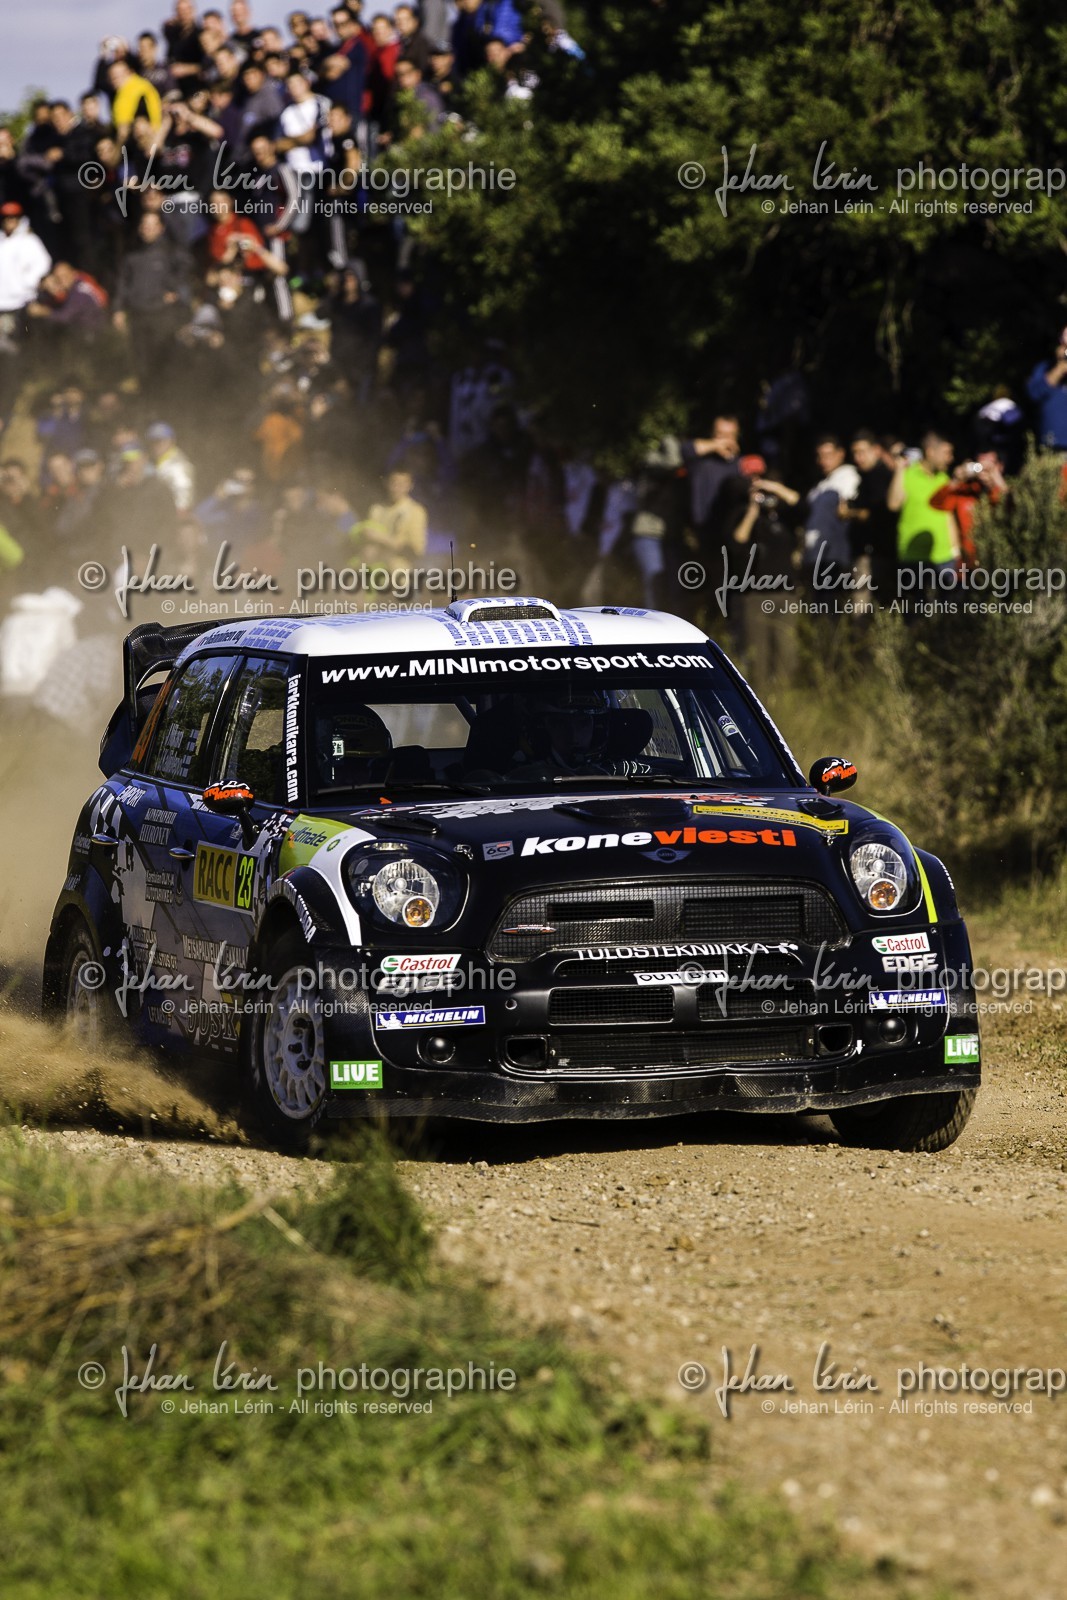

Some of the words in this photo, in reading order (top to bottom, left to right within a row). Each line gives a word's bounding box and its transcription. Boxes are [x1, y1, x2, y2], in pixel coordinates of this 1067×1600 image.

[321, 652, 713, 684] www.MINImotorsport.com
[198, 849, 233, 902] RACC
[237, 855, 255, 909] 23
[577, 942, 770, 961] TULOSTEKNIIKKA
[887, 935, 926, 951] Castrol
[399, 955, 454, 972] Castrol
[882, 952, 938, 973] EDGE
[889, 992, 942, 1004] MICHELIN
[404, 1009, 480, 1024] MICHELIN
